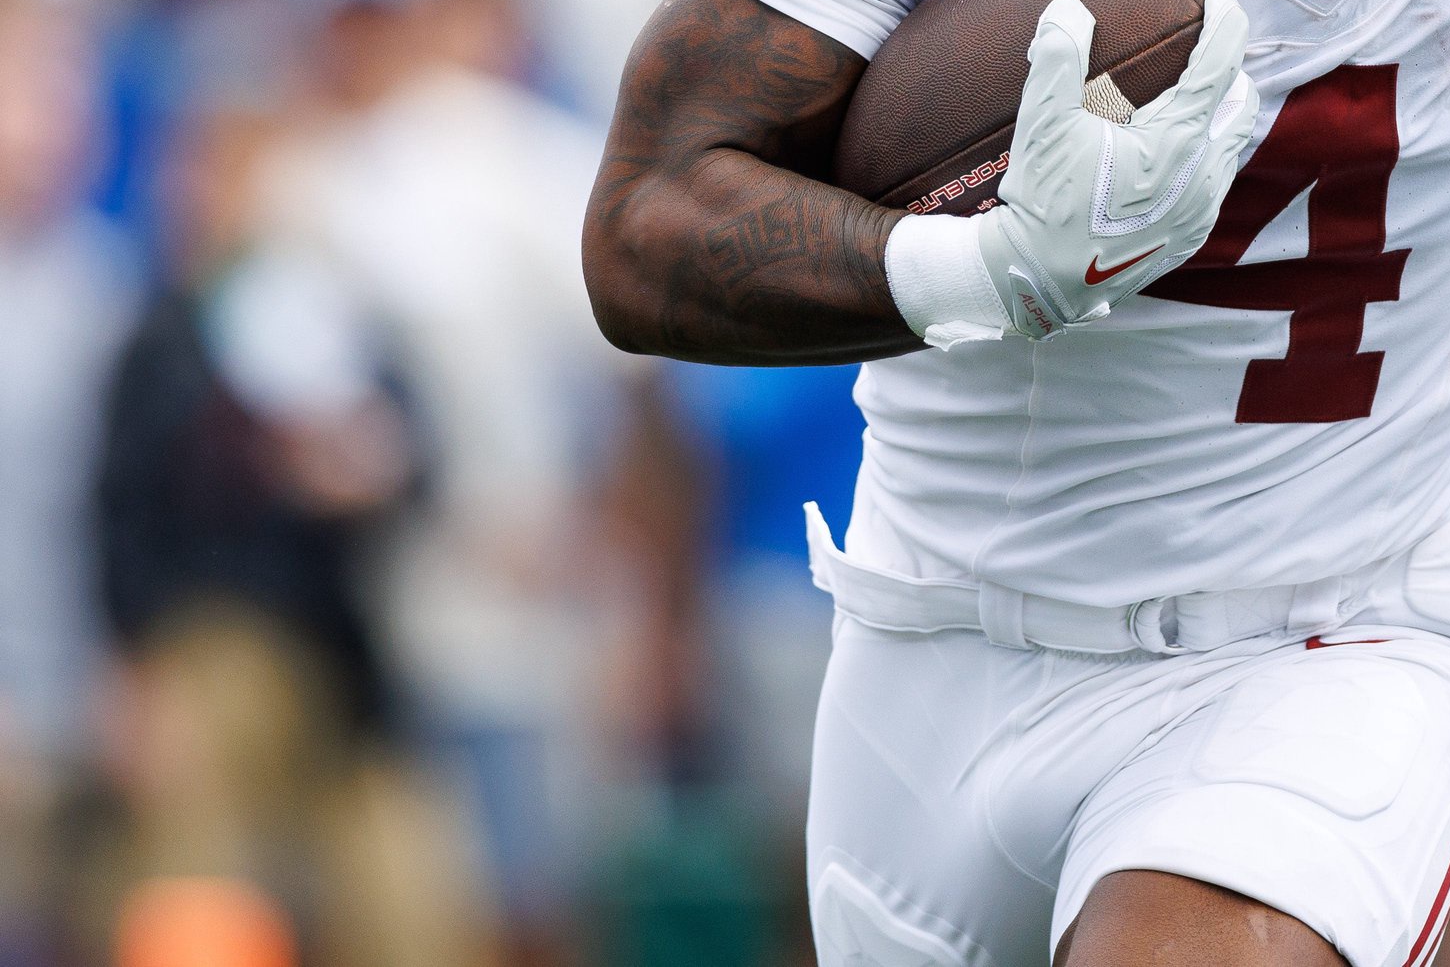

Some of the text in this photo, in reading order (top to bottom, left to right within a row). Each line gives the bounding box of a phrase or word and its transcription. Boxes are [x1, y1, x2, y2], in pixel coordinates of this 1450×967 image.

[907, 179, 965, 215] ELITE
[1137, 63, 1412, 424] 4
[1017, 292, 1053, 335] ALPHA
